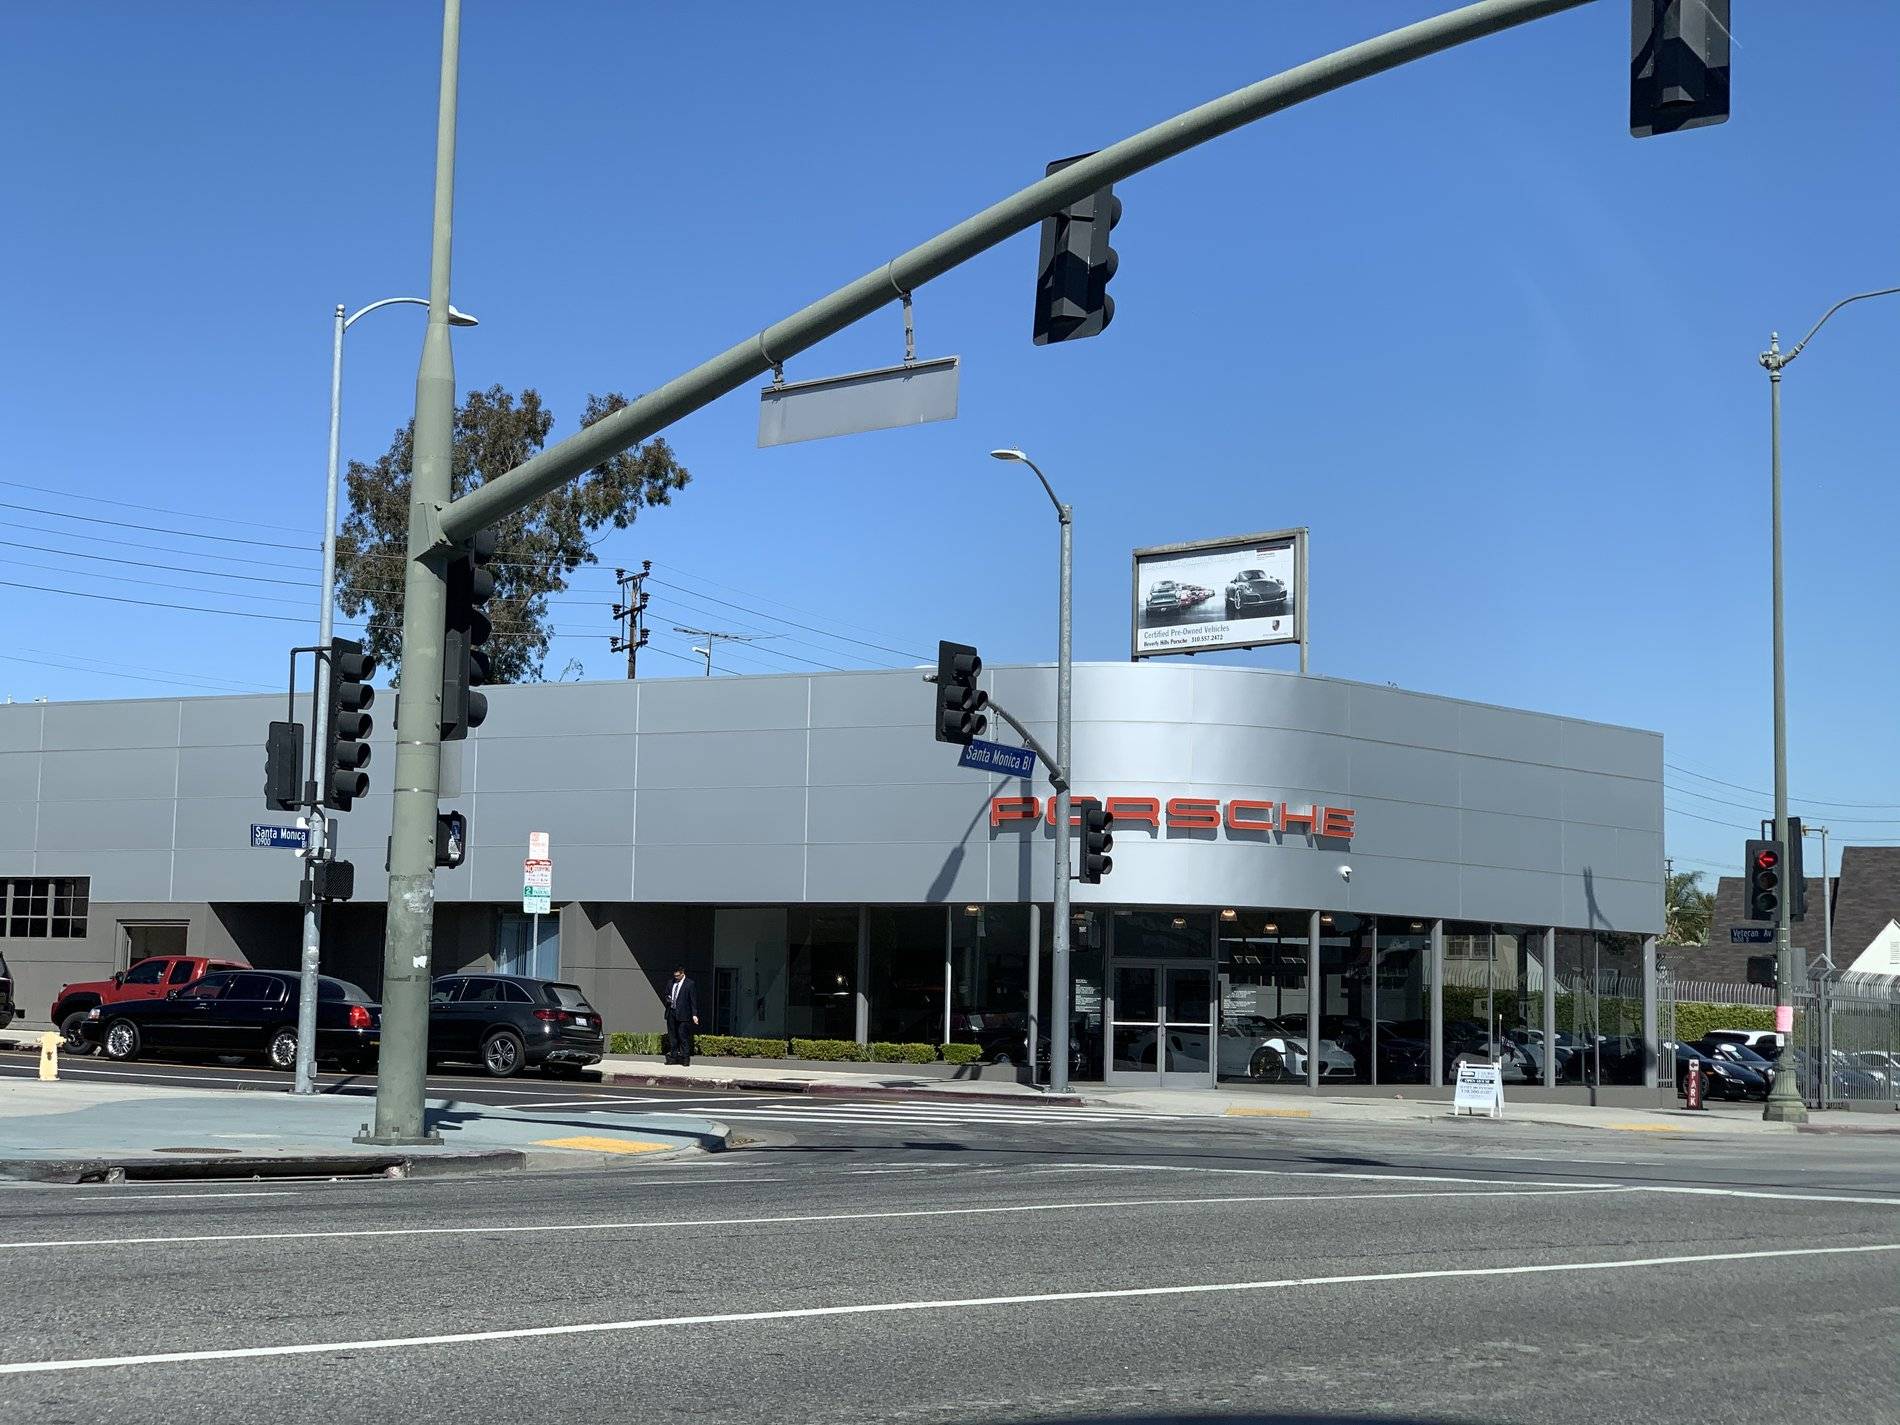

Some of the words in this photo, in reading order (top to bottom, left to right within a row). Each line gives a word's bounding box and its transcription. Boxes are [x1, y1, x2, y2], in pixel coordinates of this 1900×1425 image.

[1144, 629, 1169, 639] Certified
[1170, 627, 1202, 637] Pre-Owned
[1204, 625, 1230, 633] Vehicles
[966, 745, 991, 763] Santa
[992, 749, 1021, 768] Monica
[1022, 755, 1033, 771] Bl
[255, 826, 278, 839] Santa
[280, 828, 306, 841] Monica
[1733, 929, 1759, 937] Veteran
[1763, 929, 1772, 937] Av
